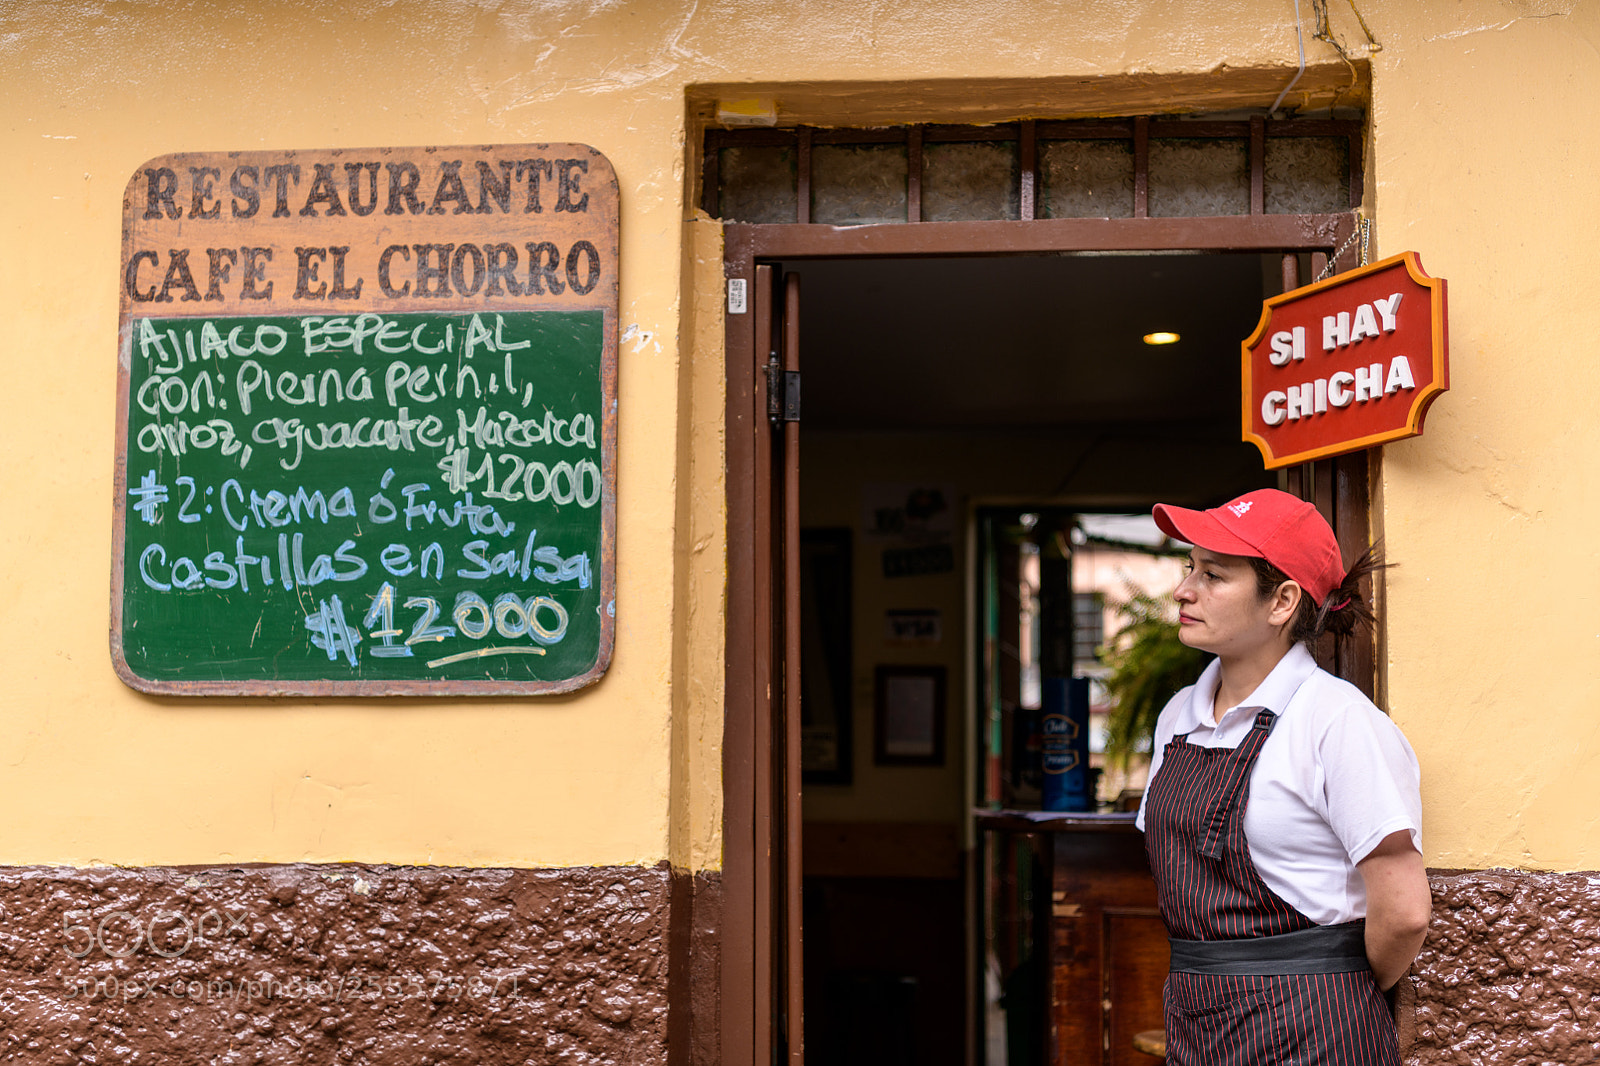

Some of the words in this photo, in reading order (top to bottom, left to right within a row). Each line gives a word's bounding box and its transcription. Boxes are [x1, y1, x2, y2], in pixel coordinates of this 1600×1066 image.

[143, 157, 590, 220] RESTAURANTE
[125, 246, 274, 303] CAFE
[292, 246, 364, 301] EL
[377, 240, 601, 299] CHORRO
[139, 316, 288, 375] AJIACO
[300, 313, 532, 359] ESPECIAL
[1269, 326, 1306, 366] SI
[1322, 292, 1403, 350] HAY
[1261, 355, 1416, 426] CHICHA
[220, 478, 357, 532] Crema
[436, 446, 601, 509] $12000
[380, 542, 445, 580] en
